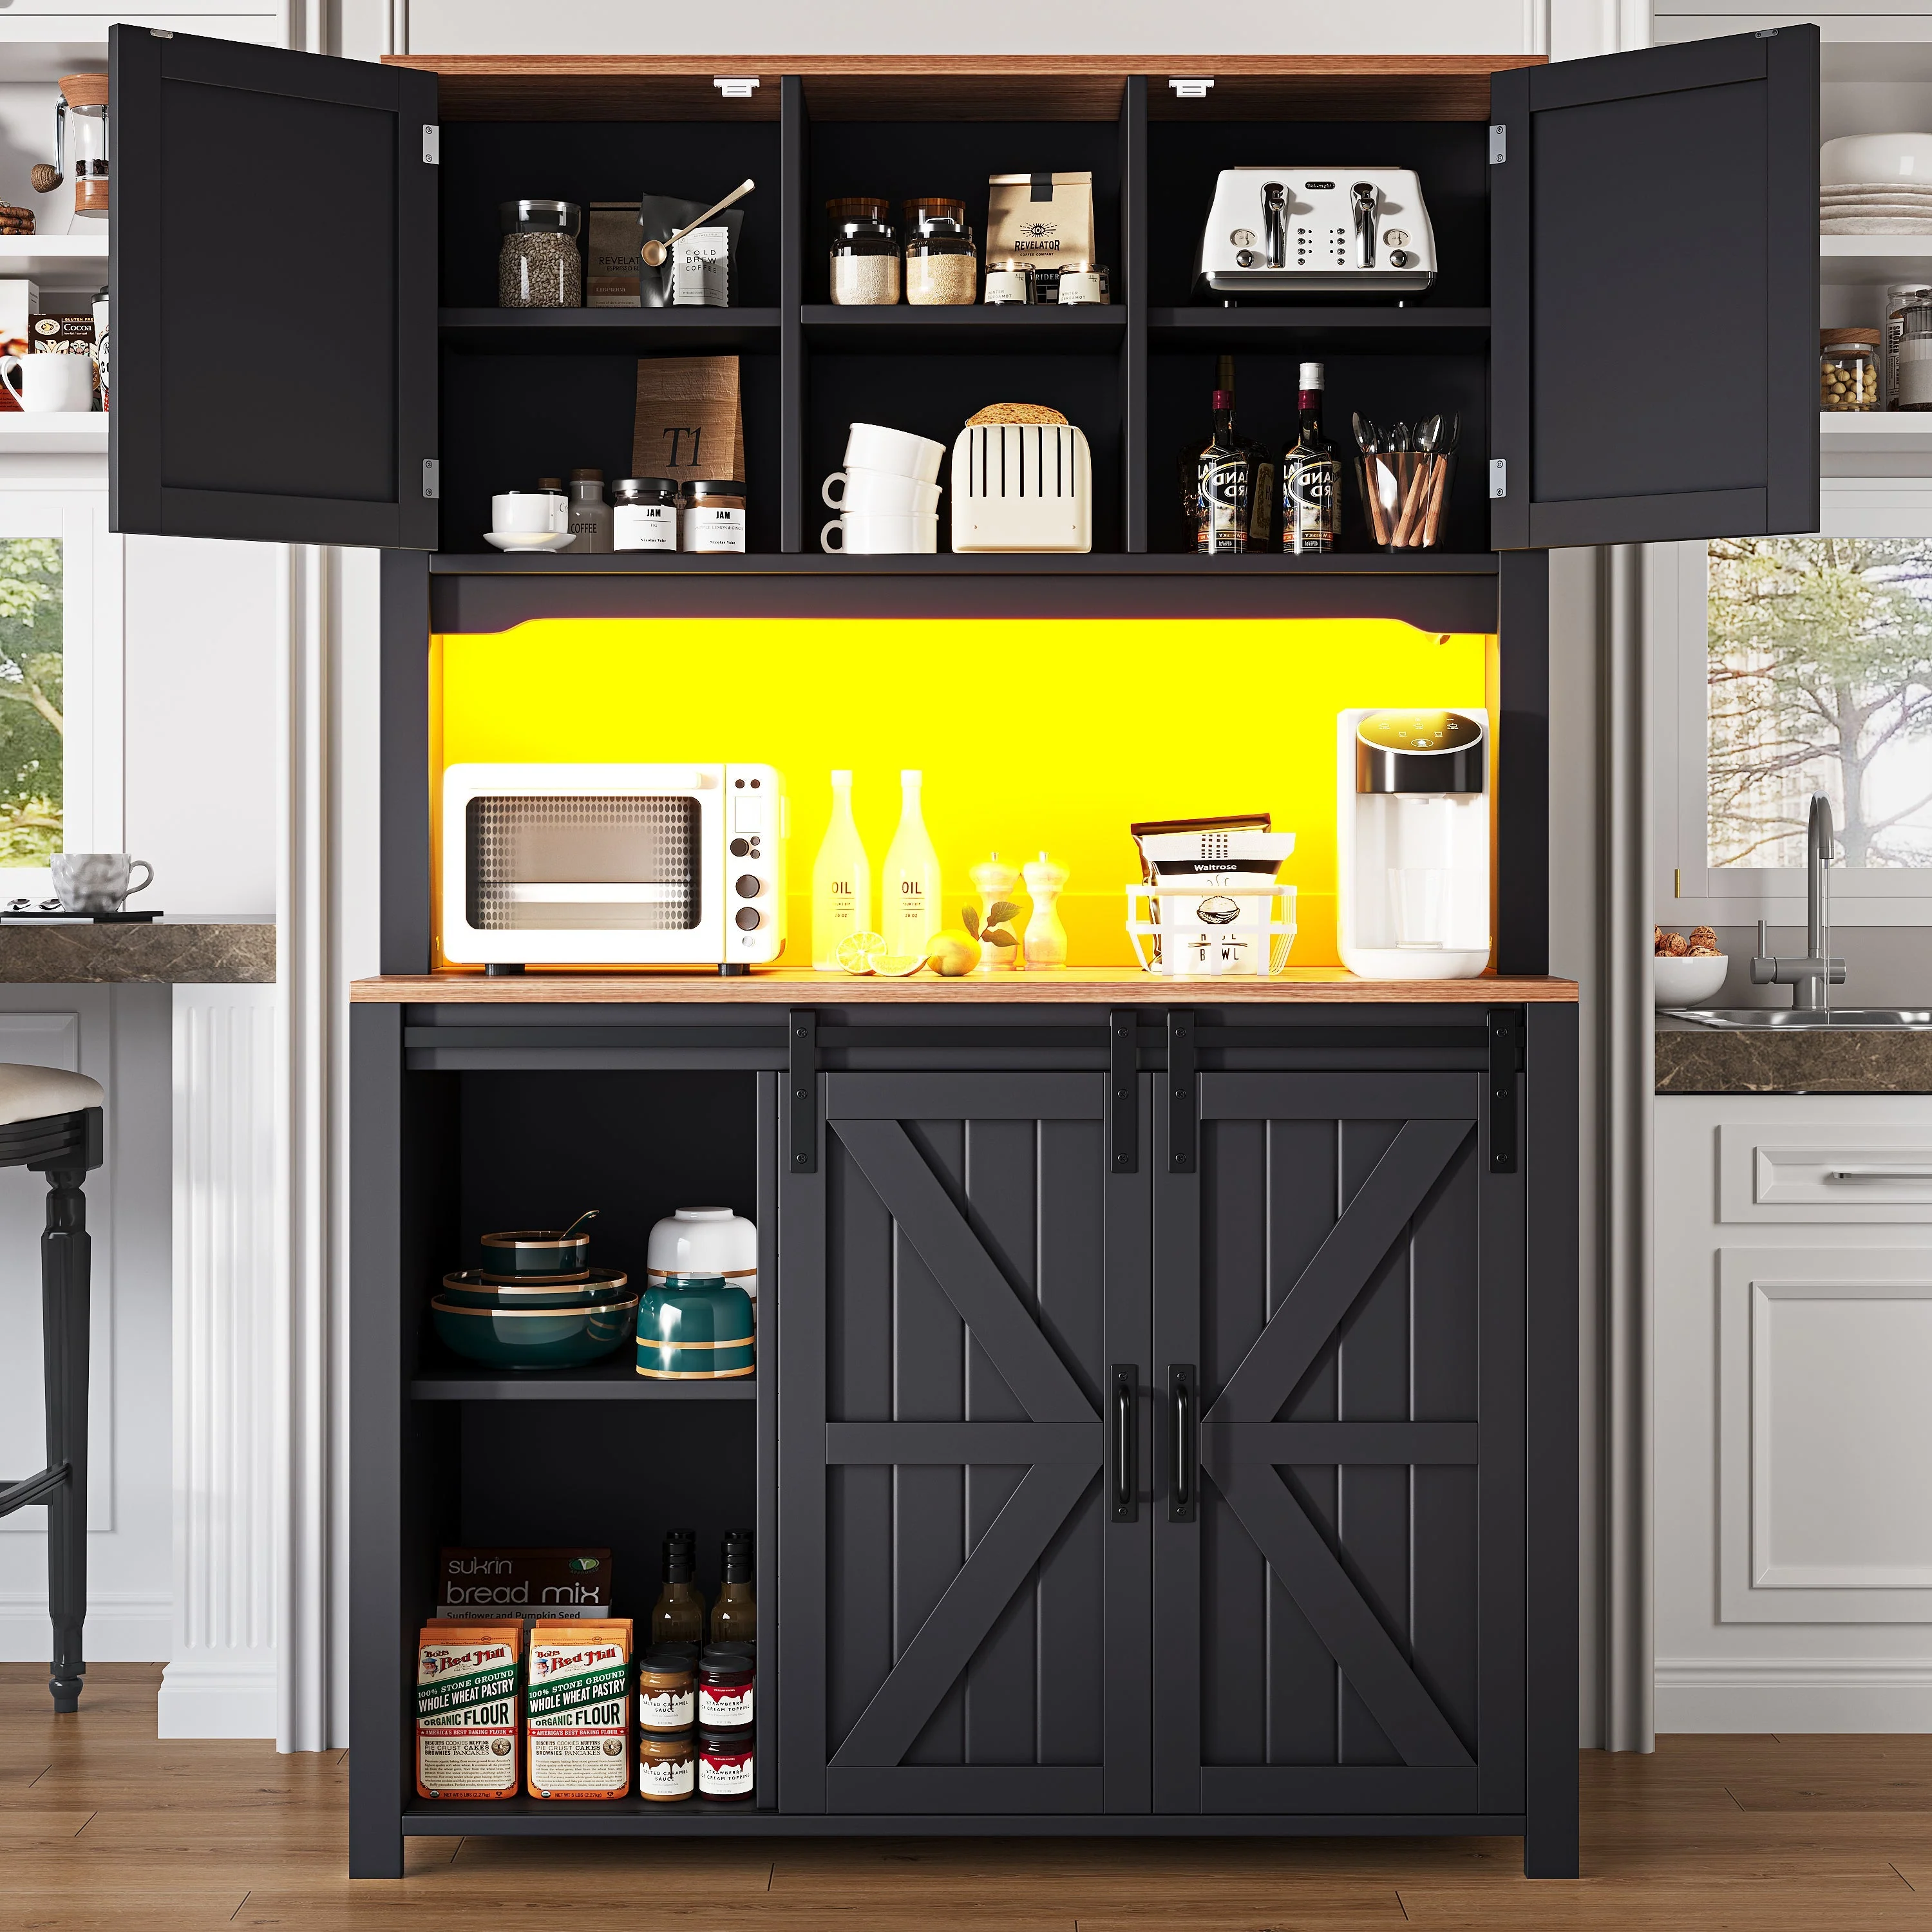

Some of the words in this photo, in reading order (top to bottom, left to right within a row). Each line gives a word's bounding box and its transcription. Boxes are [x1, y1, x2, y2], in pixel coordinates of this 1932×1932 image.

[1015, 240, 1060, 251] REVELATOR
[686, 265, 716, 273] COFFEE
[662, 426, 703, 468] T1
[647, 509, 661, 517] JAM
[571, 524, 597, 533] COFFEE
[1194, 864, 1237, 872] Waitrose
[832, 882, 851, 894] OIL
[902, 882, 922, 894] OIL
[1200, 948, 1239, 961] BWL
[448, 1557, 512, 1574] sukrin
[447, 1580, 529, 1604] bread
[542, 1582, 600, 1604] mix
[439, 1653, 471, 1673] Red
[473, 1647, 506, 1666] Mill
[550, 1653, 582, 1673] Red
[583, 1647, 617, 1666] Mill
[419, 1689, 437, 1698] 100%
[440, 1680, 471, 1693] STONE
[475, 1670, 514, 1685] GROUND
[419, 1694, 450, 1712] WHOLE
[451, 1687, 479, 1705] WHEAT
[481, 1678, 514, 1698] PASTRY
[529, 1689, 549, 1698] 100%
[552, 1680, 582, 1693] STONE
[585, 1670, 625, 1685] GROUND
[529, 1694, 560, 1713] WHOLE
[563, 1687, 591, 1705] WHEAT
[592, 1678, 625, 1698] PASTRY
[424, 1714, 461, 1726] ORGANIC
[464, 1702, 509, 1725] FLOUR
[535, 1714, 573, 1726] ORGANIC
[575, 1703, 620, 1725] FLOUR
